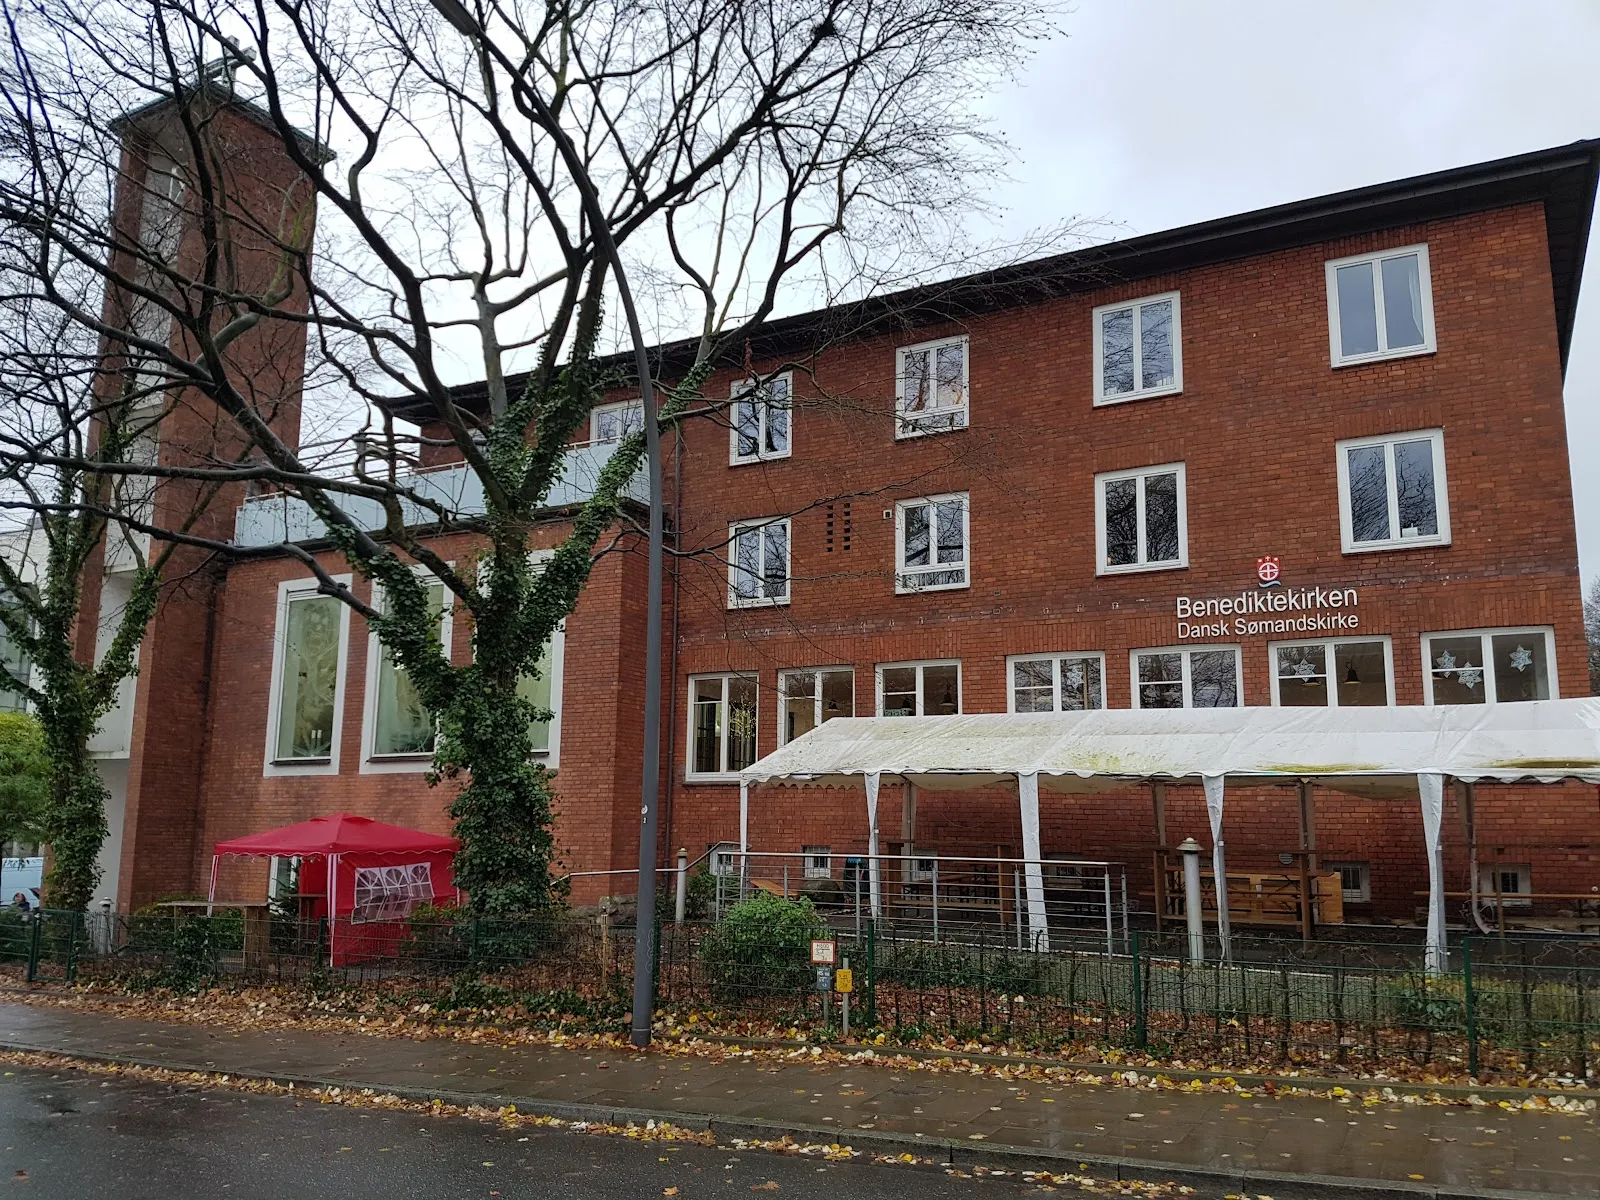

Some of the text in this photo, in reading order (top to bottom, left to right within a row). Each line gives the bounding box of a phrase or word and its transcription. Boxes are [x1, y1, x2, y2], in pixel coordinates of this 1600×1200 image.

[1176, 586, 1358, 618] Benediktekirken
[1177, 612, 1359, 639] Dansk Sømandskirke
